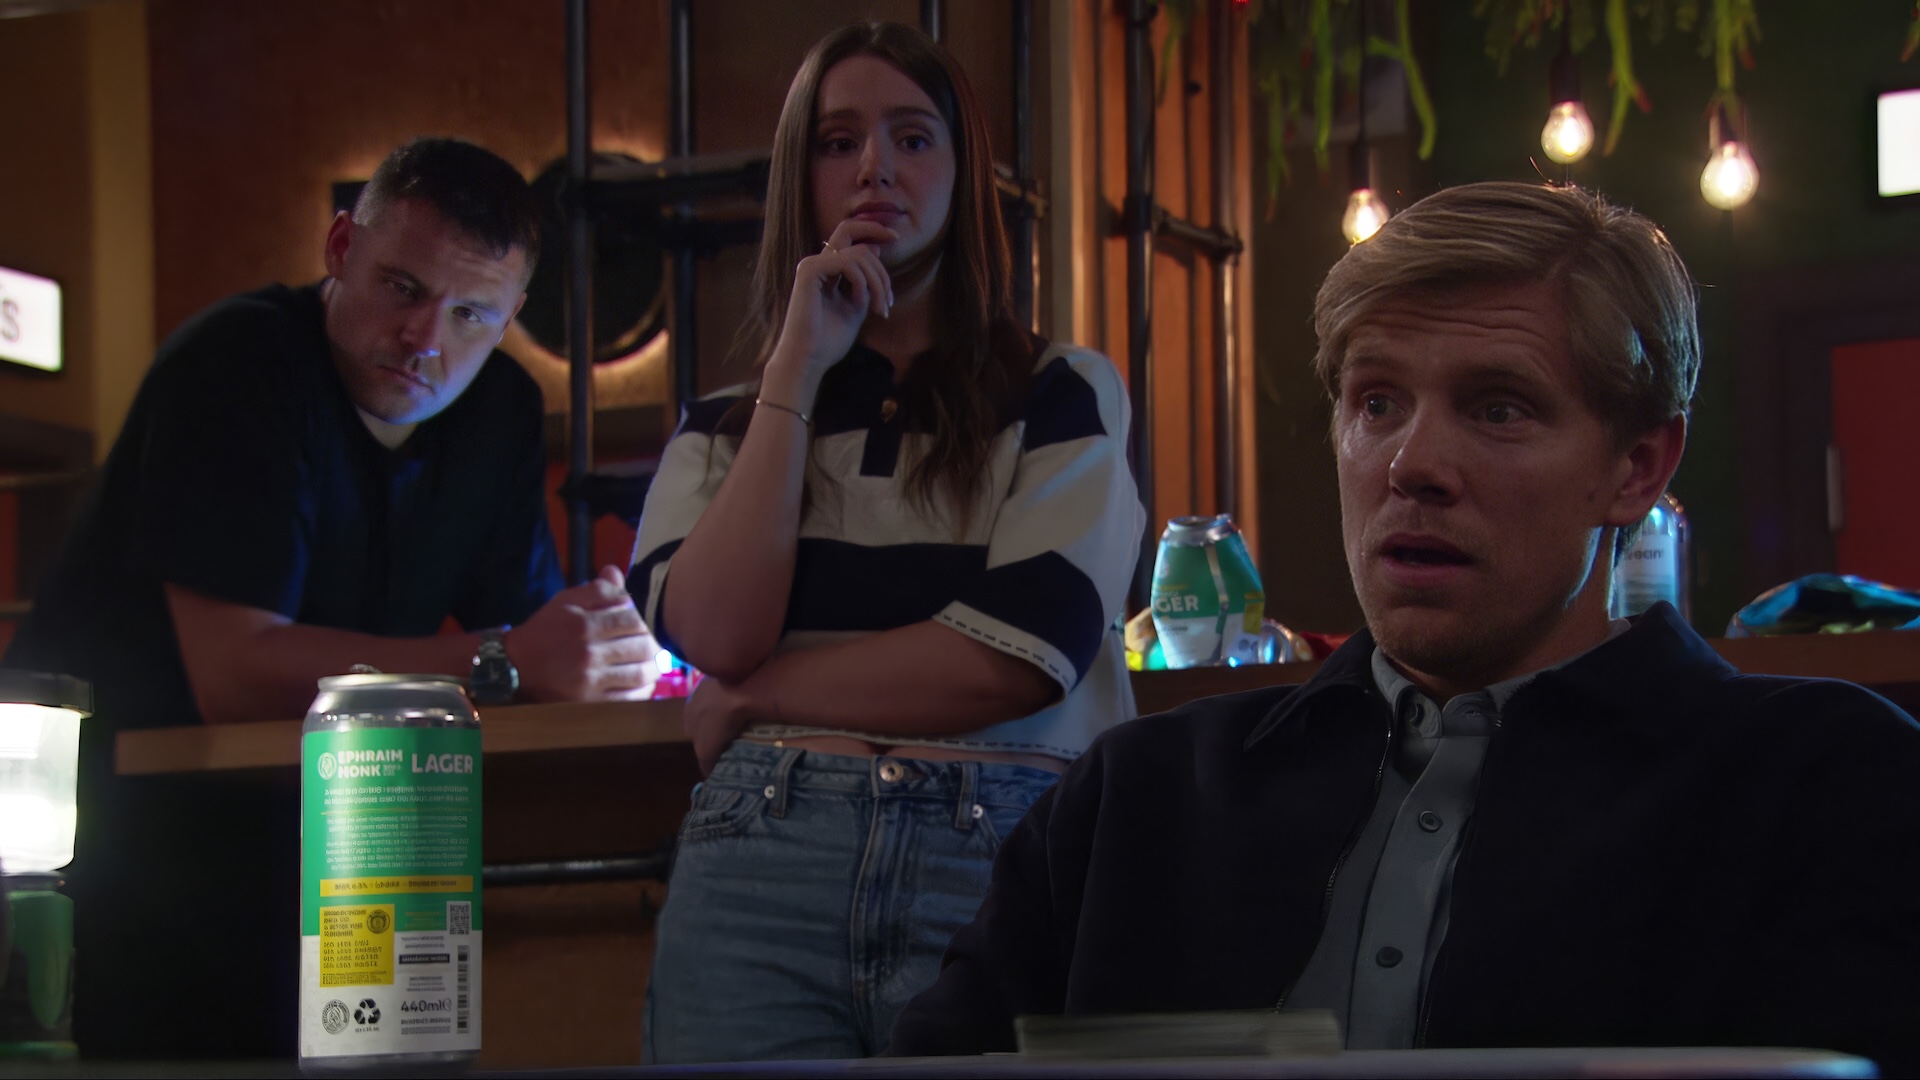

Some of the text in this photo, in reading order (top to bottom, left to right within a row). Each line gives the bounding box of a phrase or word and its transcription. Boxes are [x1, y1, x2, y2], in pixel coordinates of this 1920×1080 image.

[337, 749, 403, 764] EPHRAIM
[411, 753, 474, 774] LAGER
[337, 764, 381, 778] MONK
